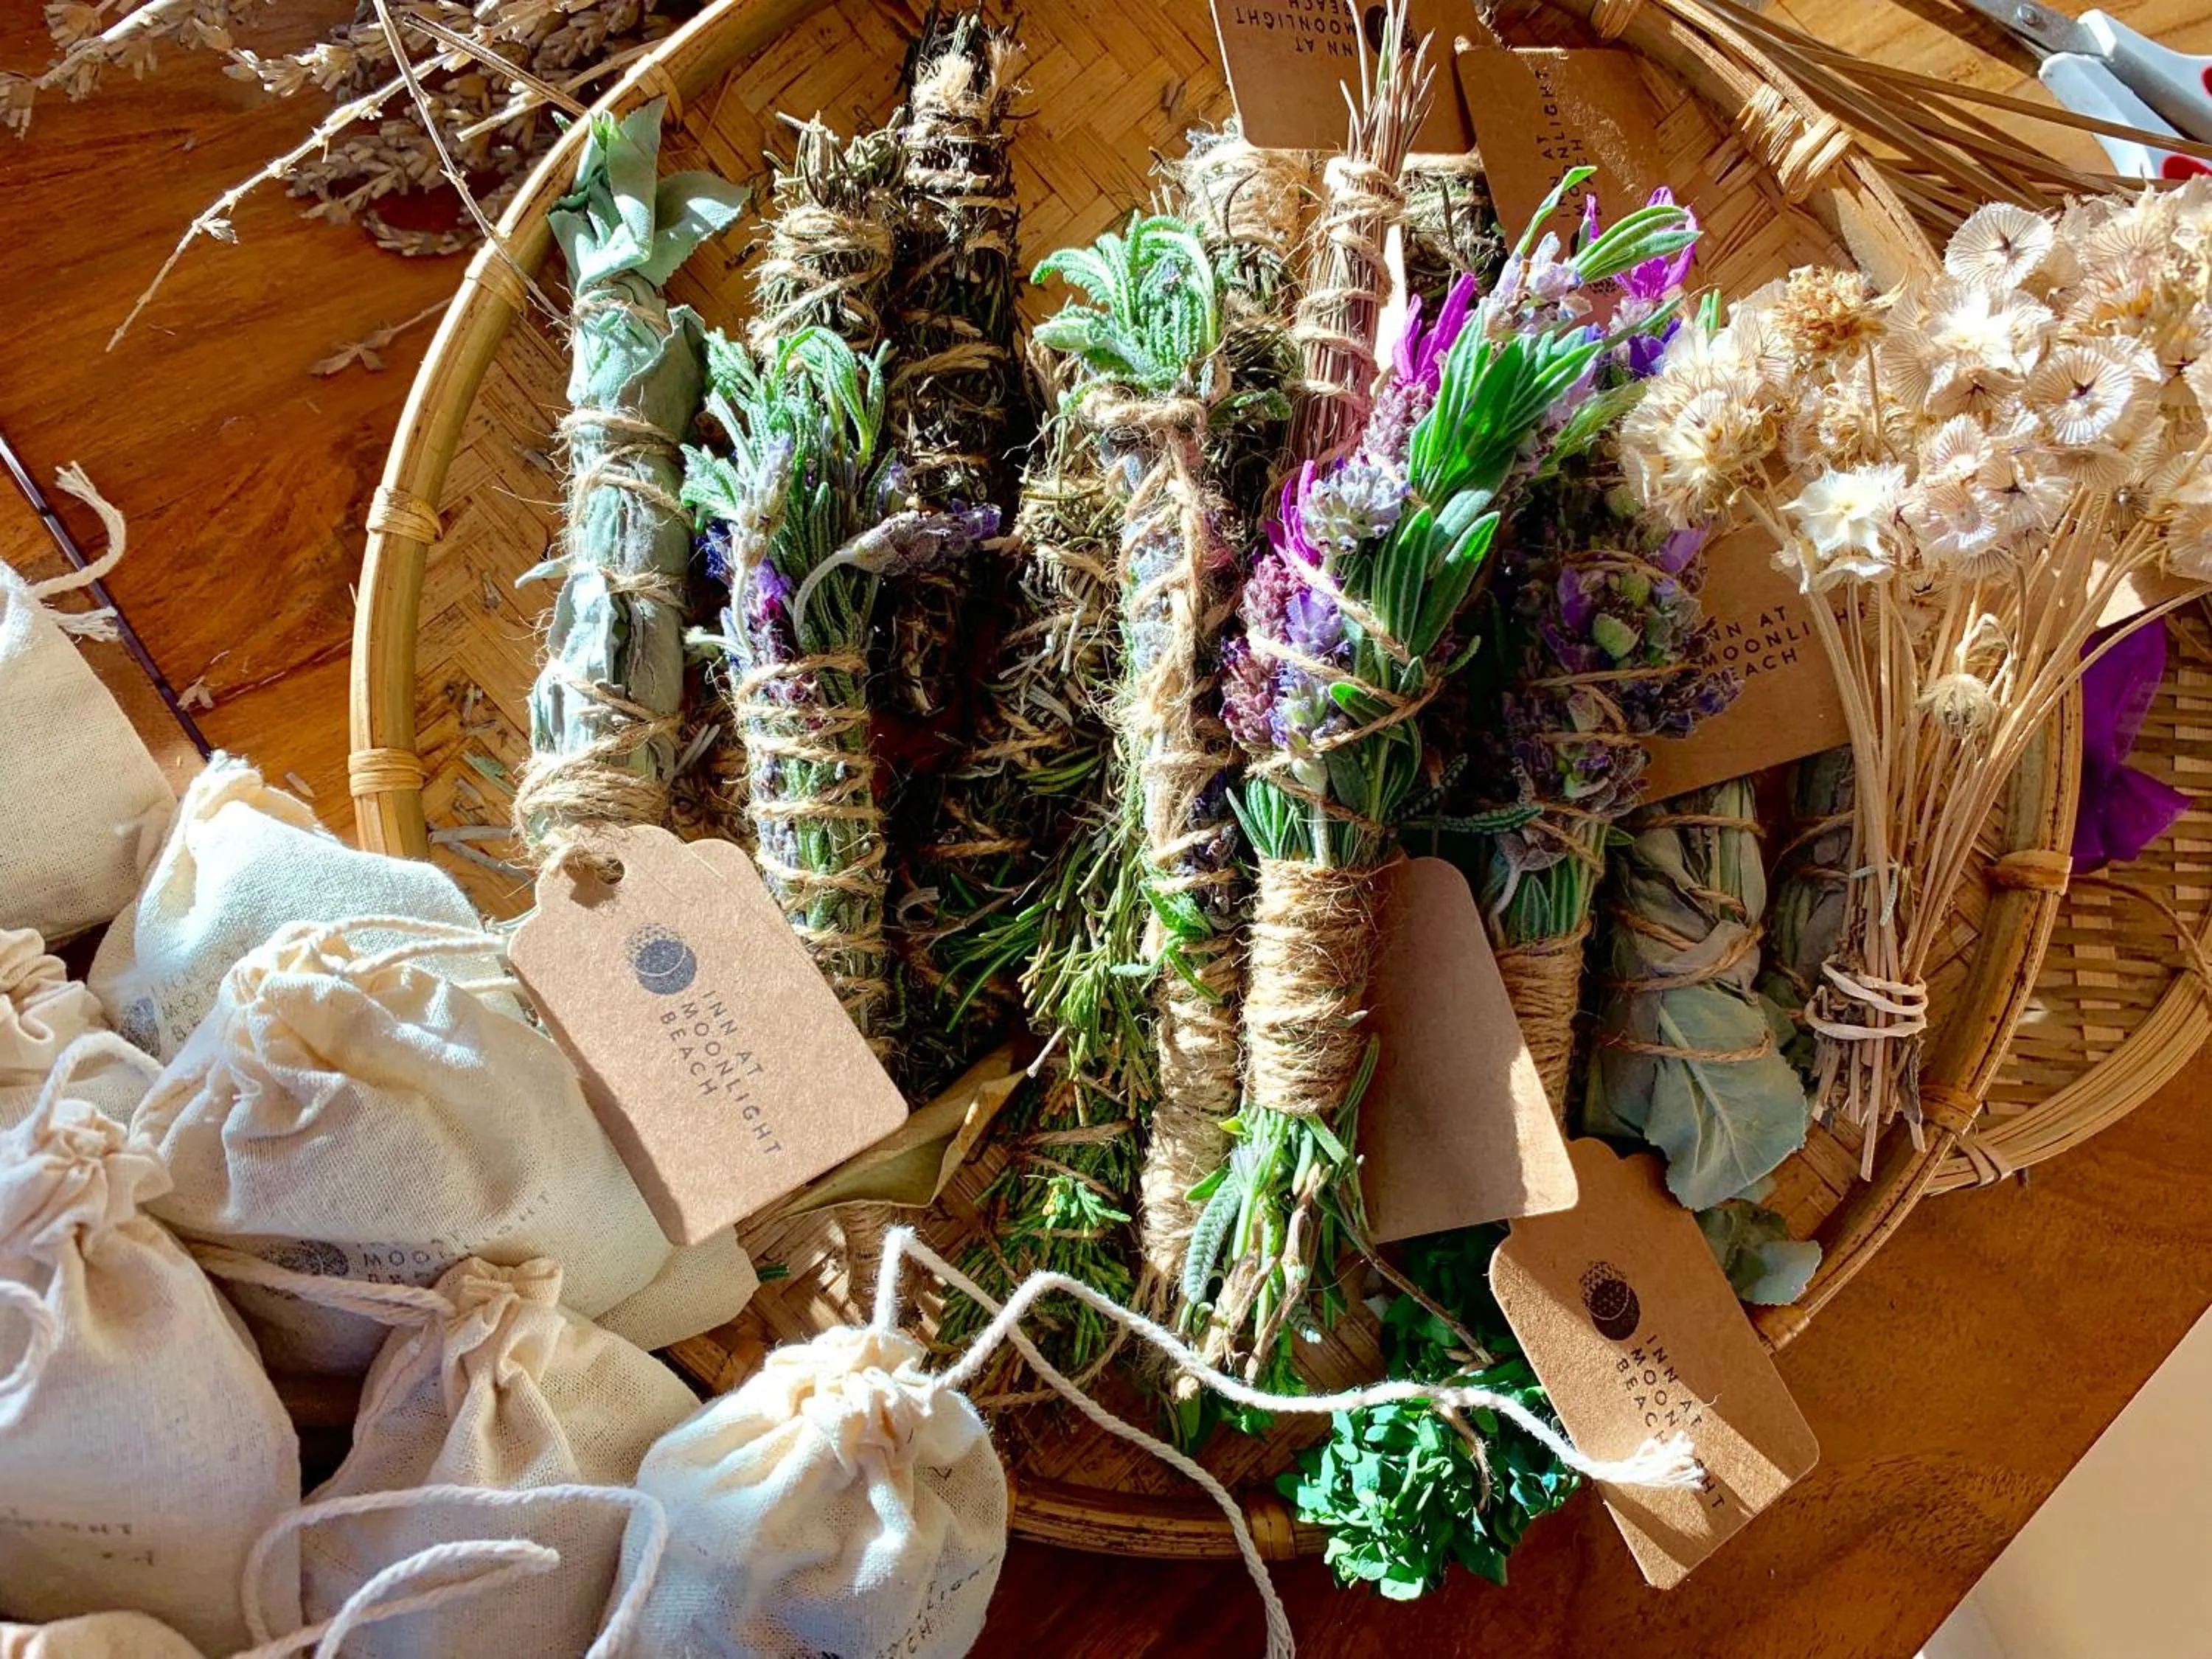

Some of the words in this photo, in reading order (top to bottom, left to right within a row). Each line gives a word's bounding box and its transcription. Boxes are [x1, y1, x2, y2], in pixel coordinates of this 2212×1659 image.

[1235, 6, 1357, 37] MOONLIGHT
[1295, 38, 1315, 54] AT
[1326, 40, 1354, 57] NN
[1536, 133, 1555, 161] AT
[1701, 601, 1865, 669] MOONLIHT
[1707, 622, 1742, 642] NN
[1759, 605, 1787, 627] AT
[660, 1011, 719, 1096] BEACH
[701, 990, 738, 1036] INN
[737, 1051, 765, 1077] AT
[681, 1001, 782, 1154] MOONLIGHT
[1645, 1334, 1679, 1384] INN
[1679, 1399, 1703, 1427] AT
